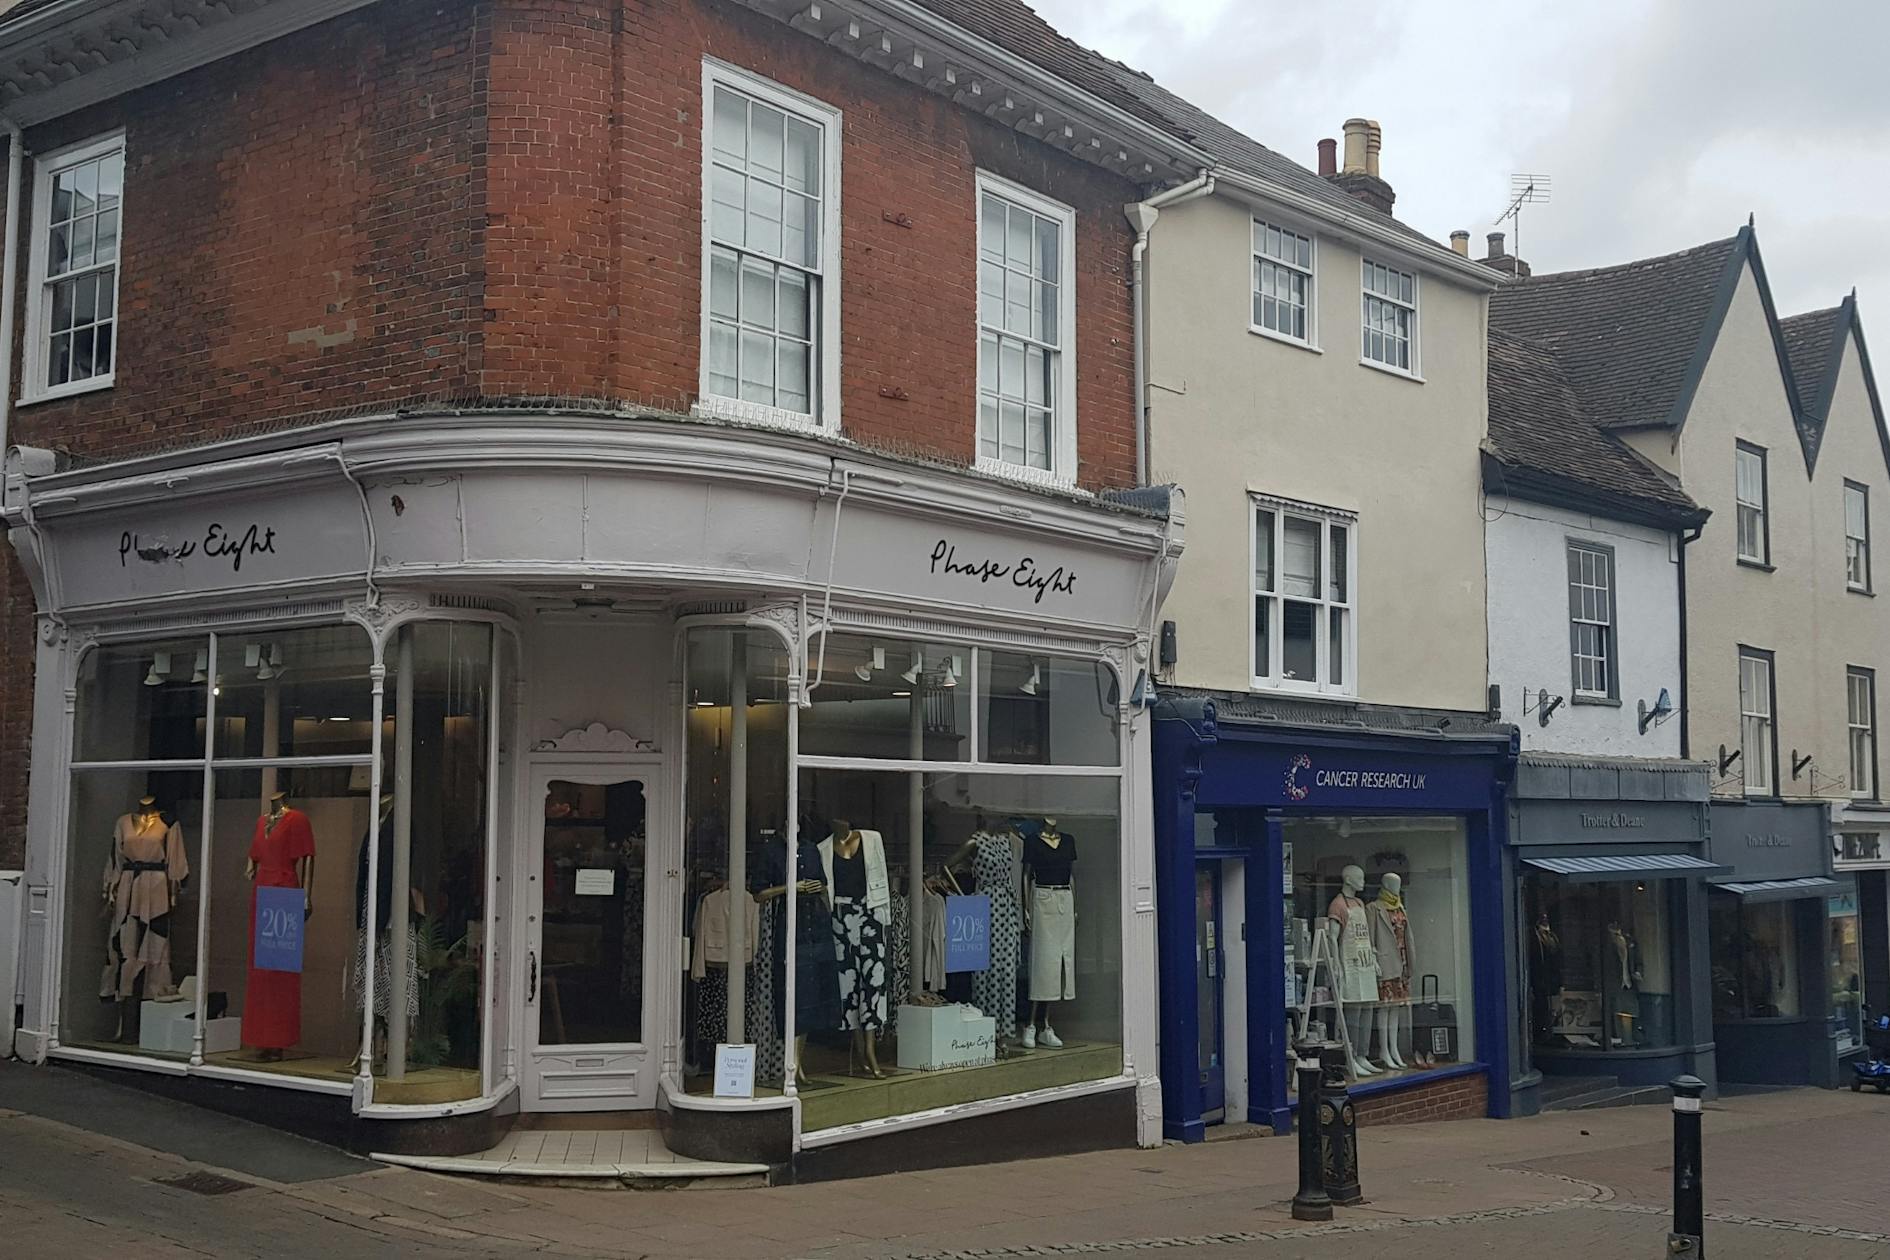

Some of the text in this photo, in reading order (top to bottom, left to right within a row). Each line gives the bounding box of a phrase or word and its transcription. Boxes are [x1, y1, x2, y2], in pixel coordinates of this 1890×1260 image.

[203, 523, 276, 571] Eight
[931, 540, 1077, 604] Phase Eight
[1316, 770, 1426, 789] CANCER RESEARCH UK
[261, 907, 298, 937] 20%
[951, 914, 984, 942] 20%
[976, 1035, 996, 1049] Eigh
